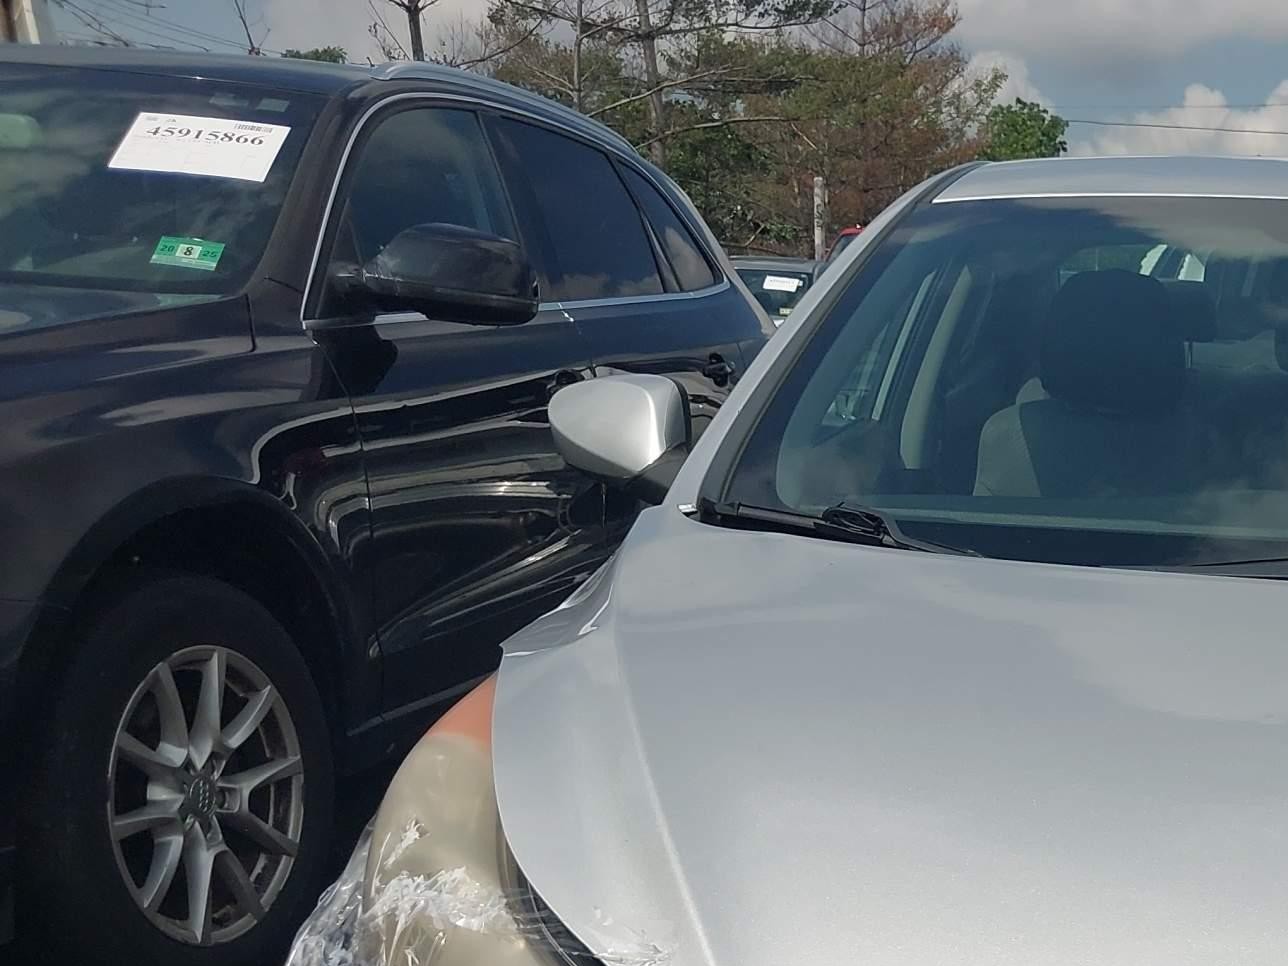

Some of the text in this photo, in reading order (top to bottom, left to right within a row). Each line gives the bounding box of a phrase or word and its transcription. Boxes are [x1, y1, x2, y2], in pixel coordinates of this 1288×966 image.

[147, 126, 264, 146] 45915866
[160, 244, 175, 252] 20
[183, 246, 194, 256] 8
